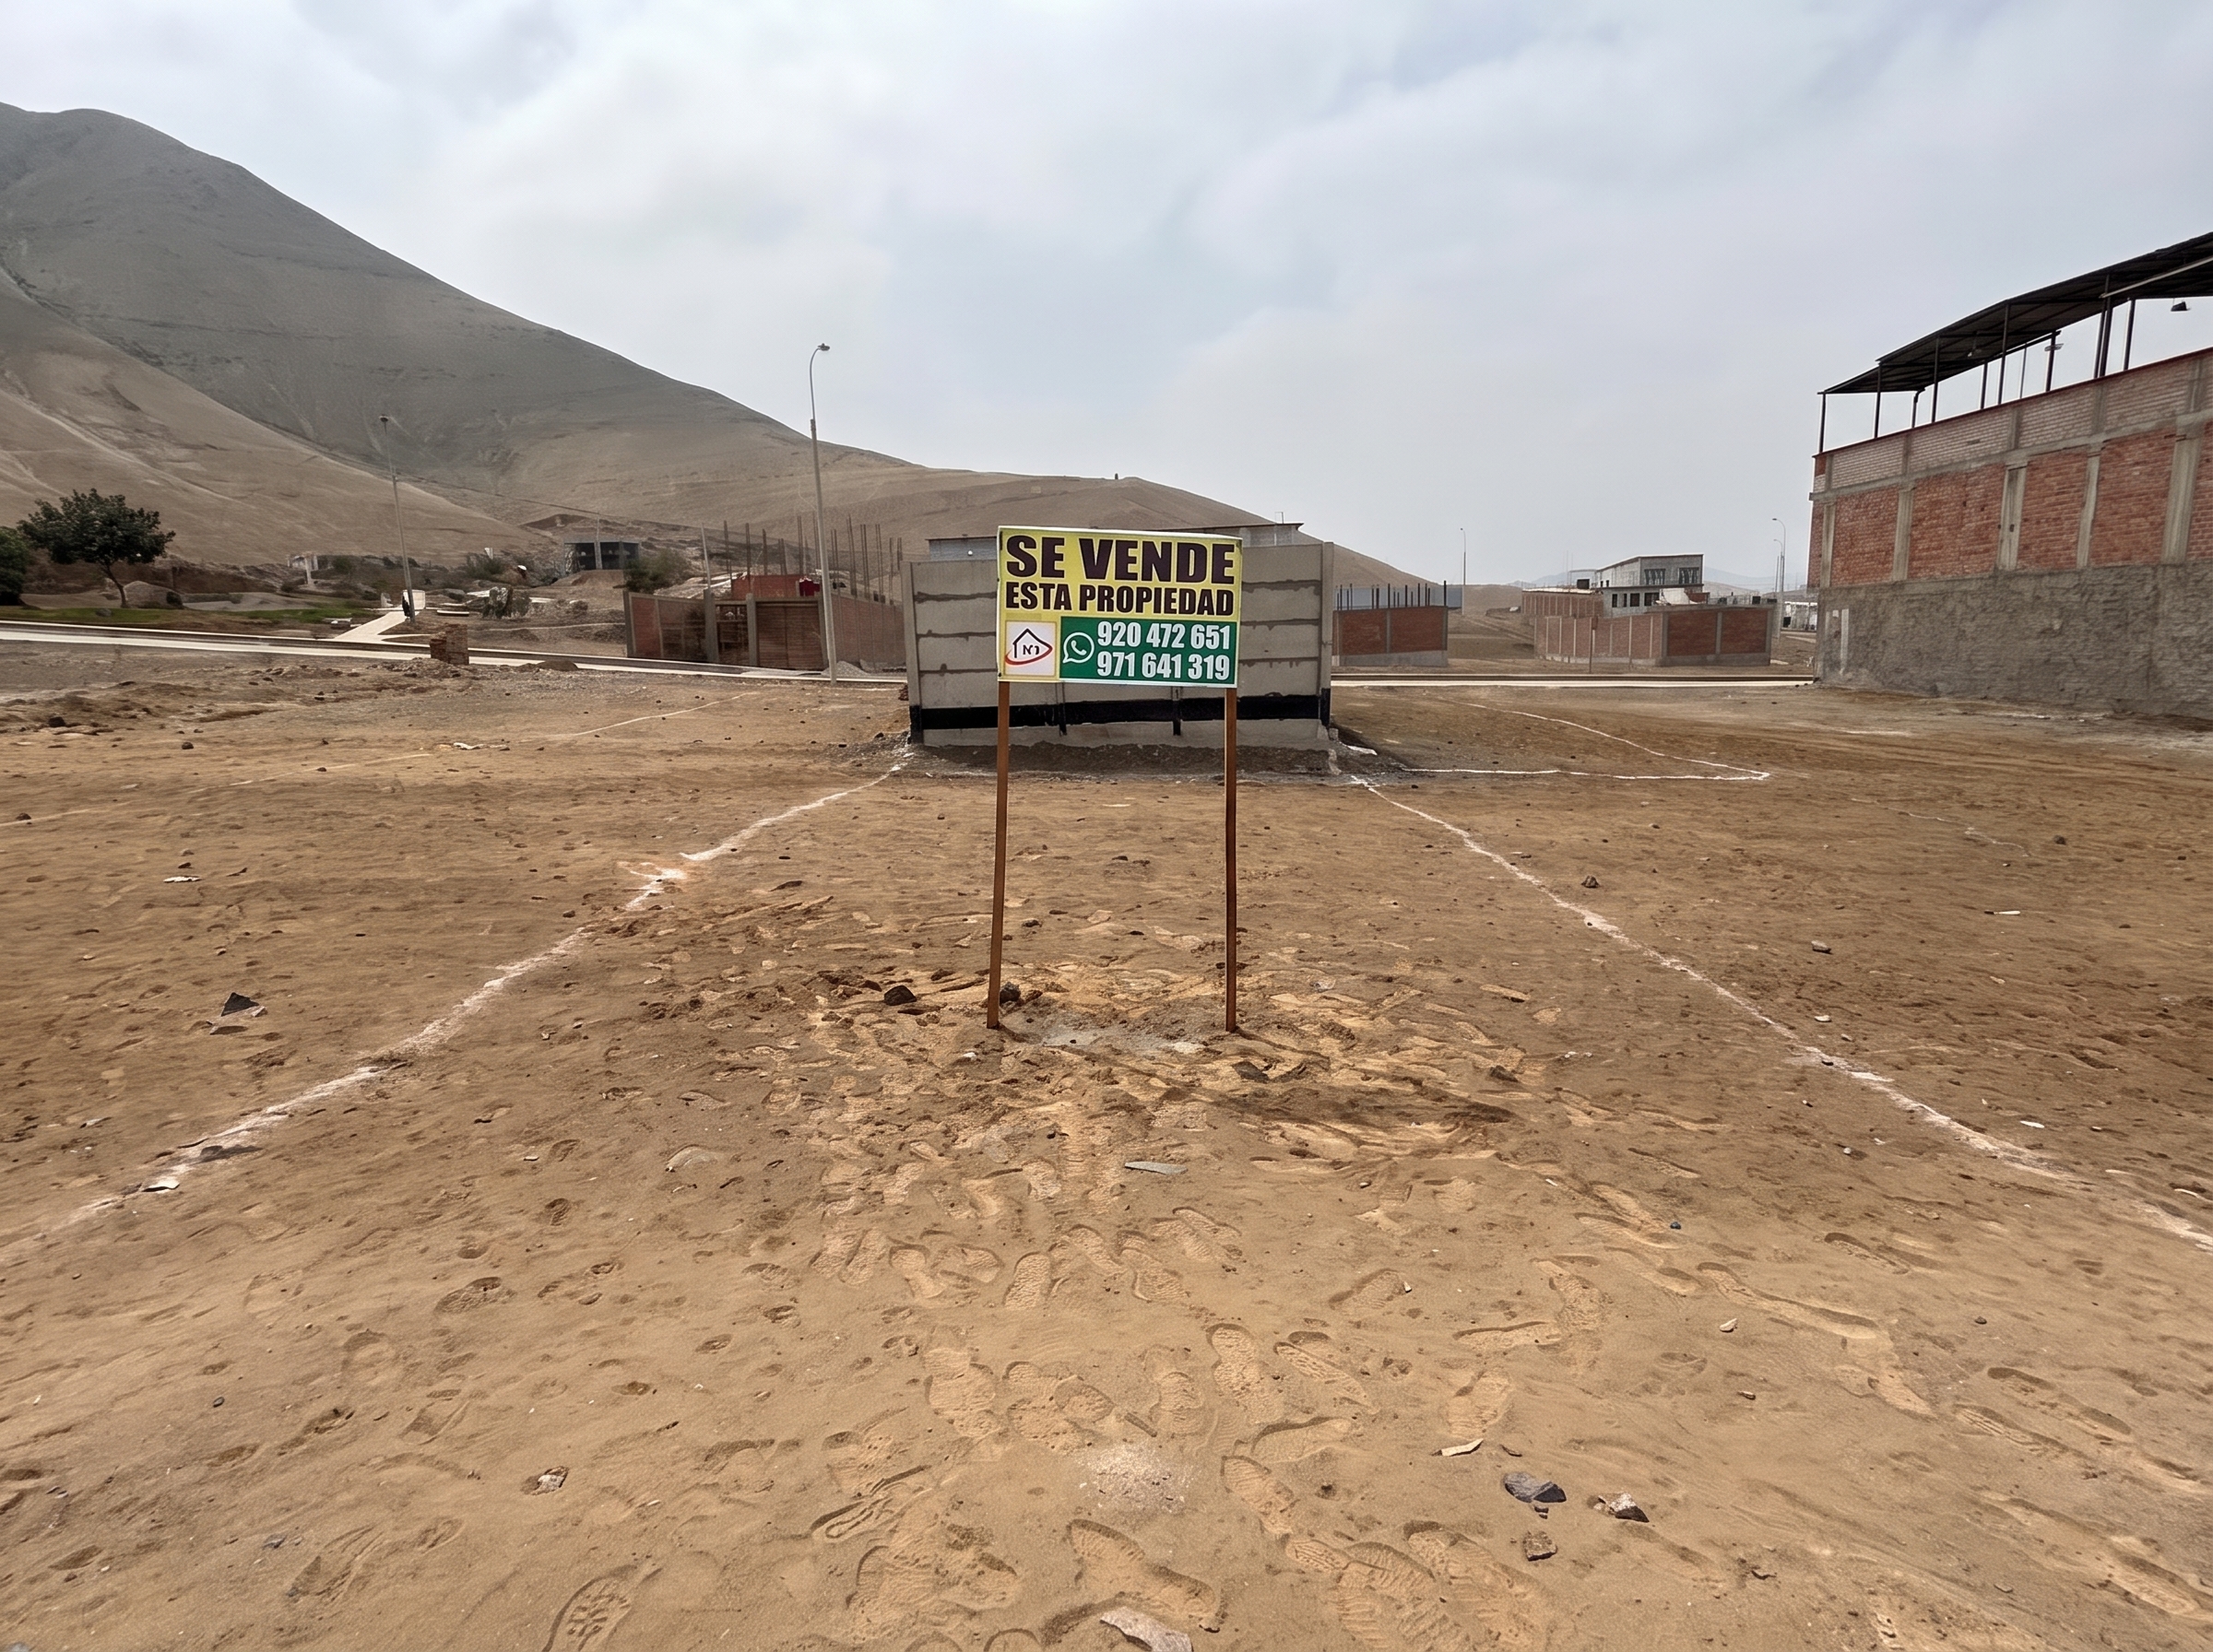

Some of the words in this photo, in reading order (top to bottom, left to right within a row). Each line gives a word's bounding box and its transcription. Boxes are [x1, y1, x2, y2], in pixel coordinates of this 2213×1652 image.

[1006, 535, 1065, 579] SE
[1079, 538, 1235, 584] VENDE
[1006, 582, 1071, 610] ESTA
[1079, 584, 1234, 616] PROPIEDAD
[1097, 620, 1141, 648] 920
[1146, 623, 1186, 649] 472
[1190, 624, 1231, 650] 651
[1097, 651, 1135, 678] 971
[1142, 653, 1182, 679] 641
[1188, 655, 1230, 680] 319
